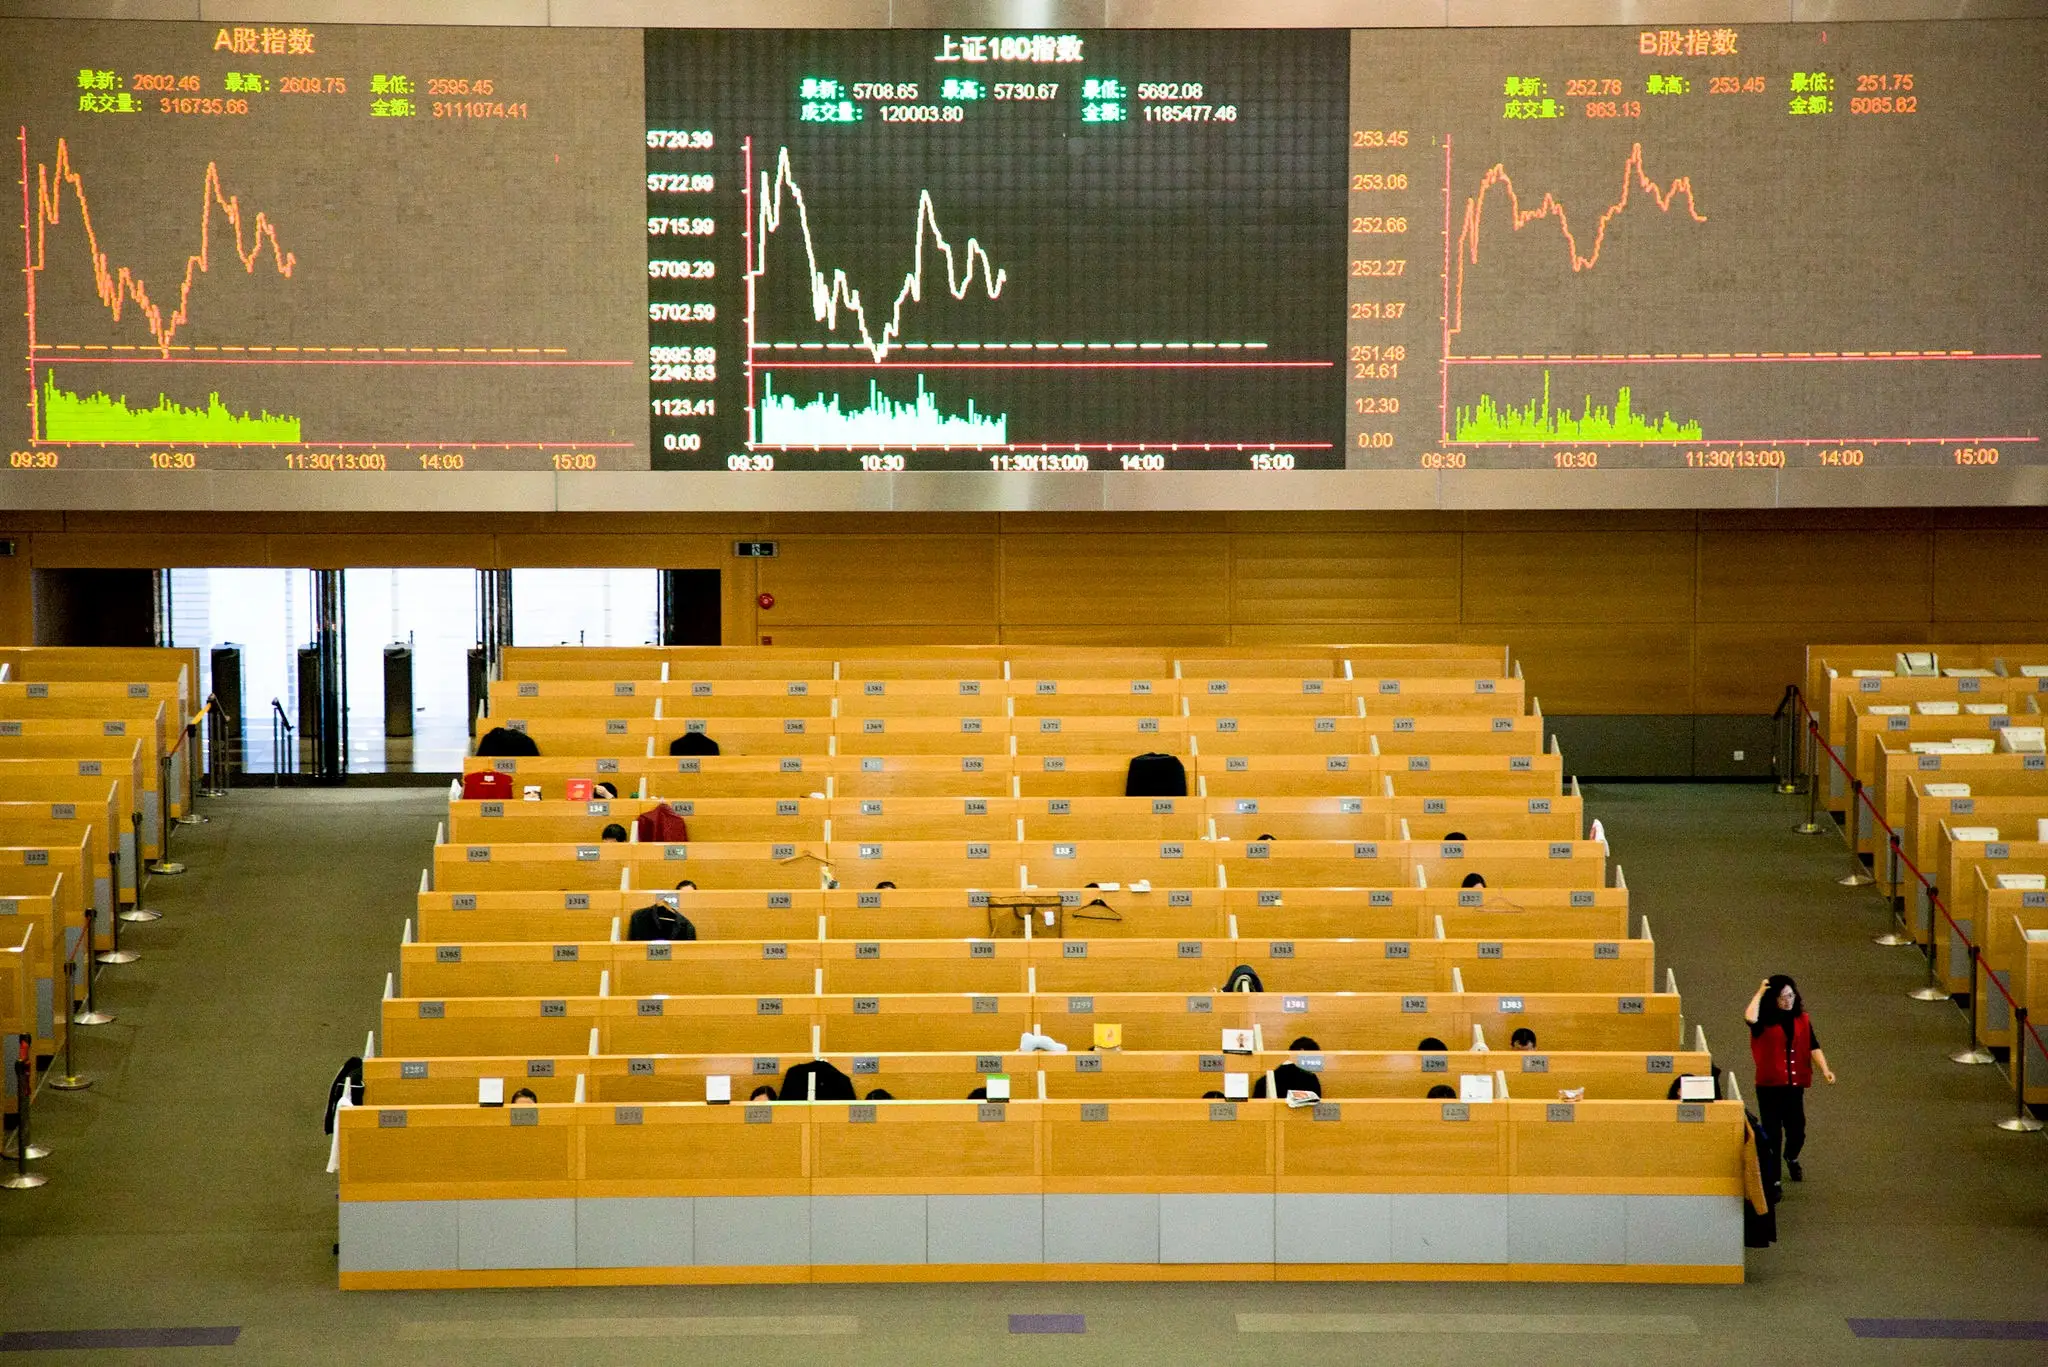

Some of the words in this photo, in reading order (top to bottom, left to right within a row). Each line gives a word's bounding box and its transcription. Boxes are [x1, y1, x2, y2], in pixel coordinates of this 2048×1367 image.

[214, 28, 315, 54] A股指数
[934, 34, 1084, 62] 上证180指数
[1638, 28, 1738, 56] B股指数
[132, 74, 200, 91] 2602.46
[280, 77, 347, 94] 2609.75
[427, 78, 494, 96] 2595.45
[853, 82, 918, 100] 5708.65
[994, 83, 1058, 100] 5730.67
[1137, 82, 1203, 100] 5692.08
[1566, 79, 1622, 96] 252.78
[1709, 76, 1765, 94] 253.45
[1856, 74, 1914, 92] 251.75
[160, 98, 248, 114] 316735.66
[432, 102, 528, 119] 3111074.41
[880, 106, 964, 123] 120003.80
[1143, 106, 1237, 122] 1185477.46
[1586, 101, 1641, 118] 863.13
[1352, 130, 1409, 148] 253.45
[1352, 174, 1408, 190] 253.06
[648, 217, 714, 236] 5715.99
[1352, 217, 1408, 233] 252.66
[1352, 260, 1406, 276] 252.27
[649, 303, 716, 322] 5702.59
[1351, 303, 1406, 319] 251.87
[1351, 346, 1406, 362] 251.48
[1355, 364, 1398, 379] 24.61
[652, 399, 715, 416] 1123.41
[1356, 398, 1399, 414] 12.30
[664, 434, 701, 451] 0.00
[1358, 432, 1394, 448] 0.00
[10, 452, 58, 468] 09:30
[150, 453, 196, 470] 10:30
[285, 453, 387, 470] 11:30(13:00)
[420, 454, 464, 470] 14:00
[552, 454, 596, 470] 15:00
[727, 454, 774, 471] 09:30
[860, 454, 904, 471] 10:30
[990, 454, 1089, 472] 11:30(13:00)
[1120, 454, 1164, 470] 14:00
[1250, 454, 1294, 470] 15:00
[1422, 453, 1466, 468] 09:30
[1553, 452, 1598, 468] 10:30
[1686, 450, 1786, 469] 11:30(13:00)
[1818, 450, 1864, 466] 14:00
[1954, 448, 1998, 465] 15:00
